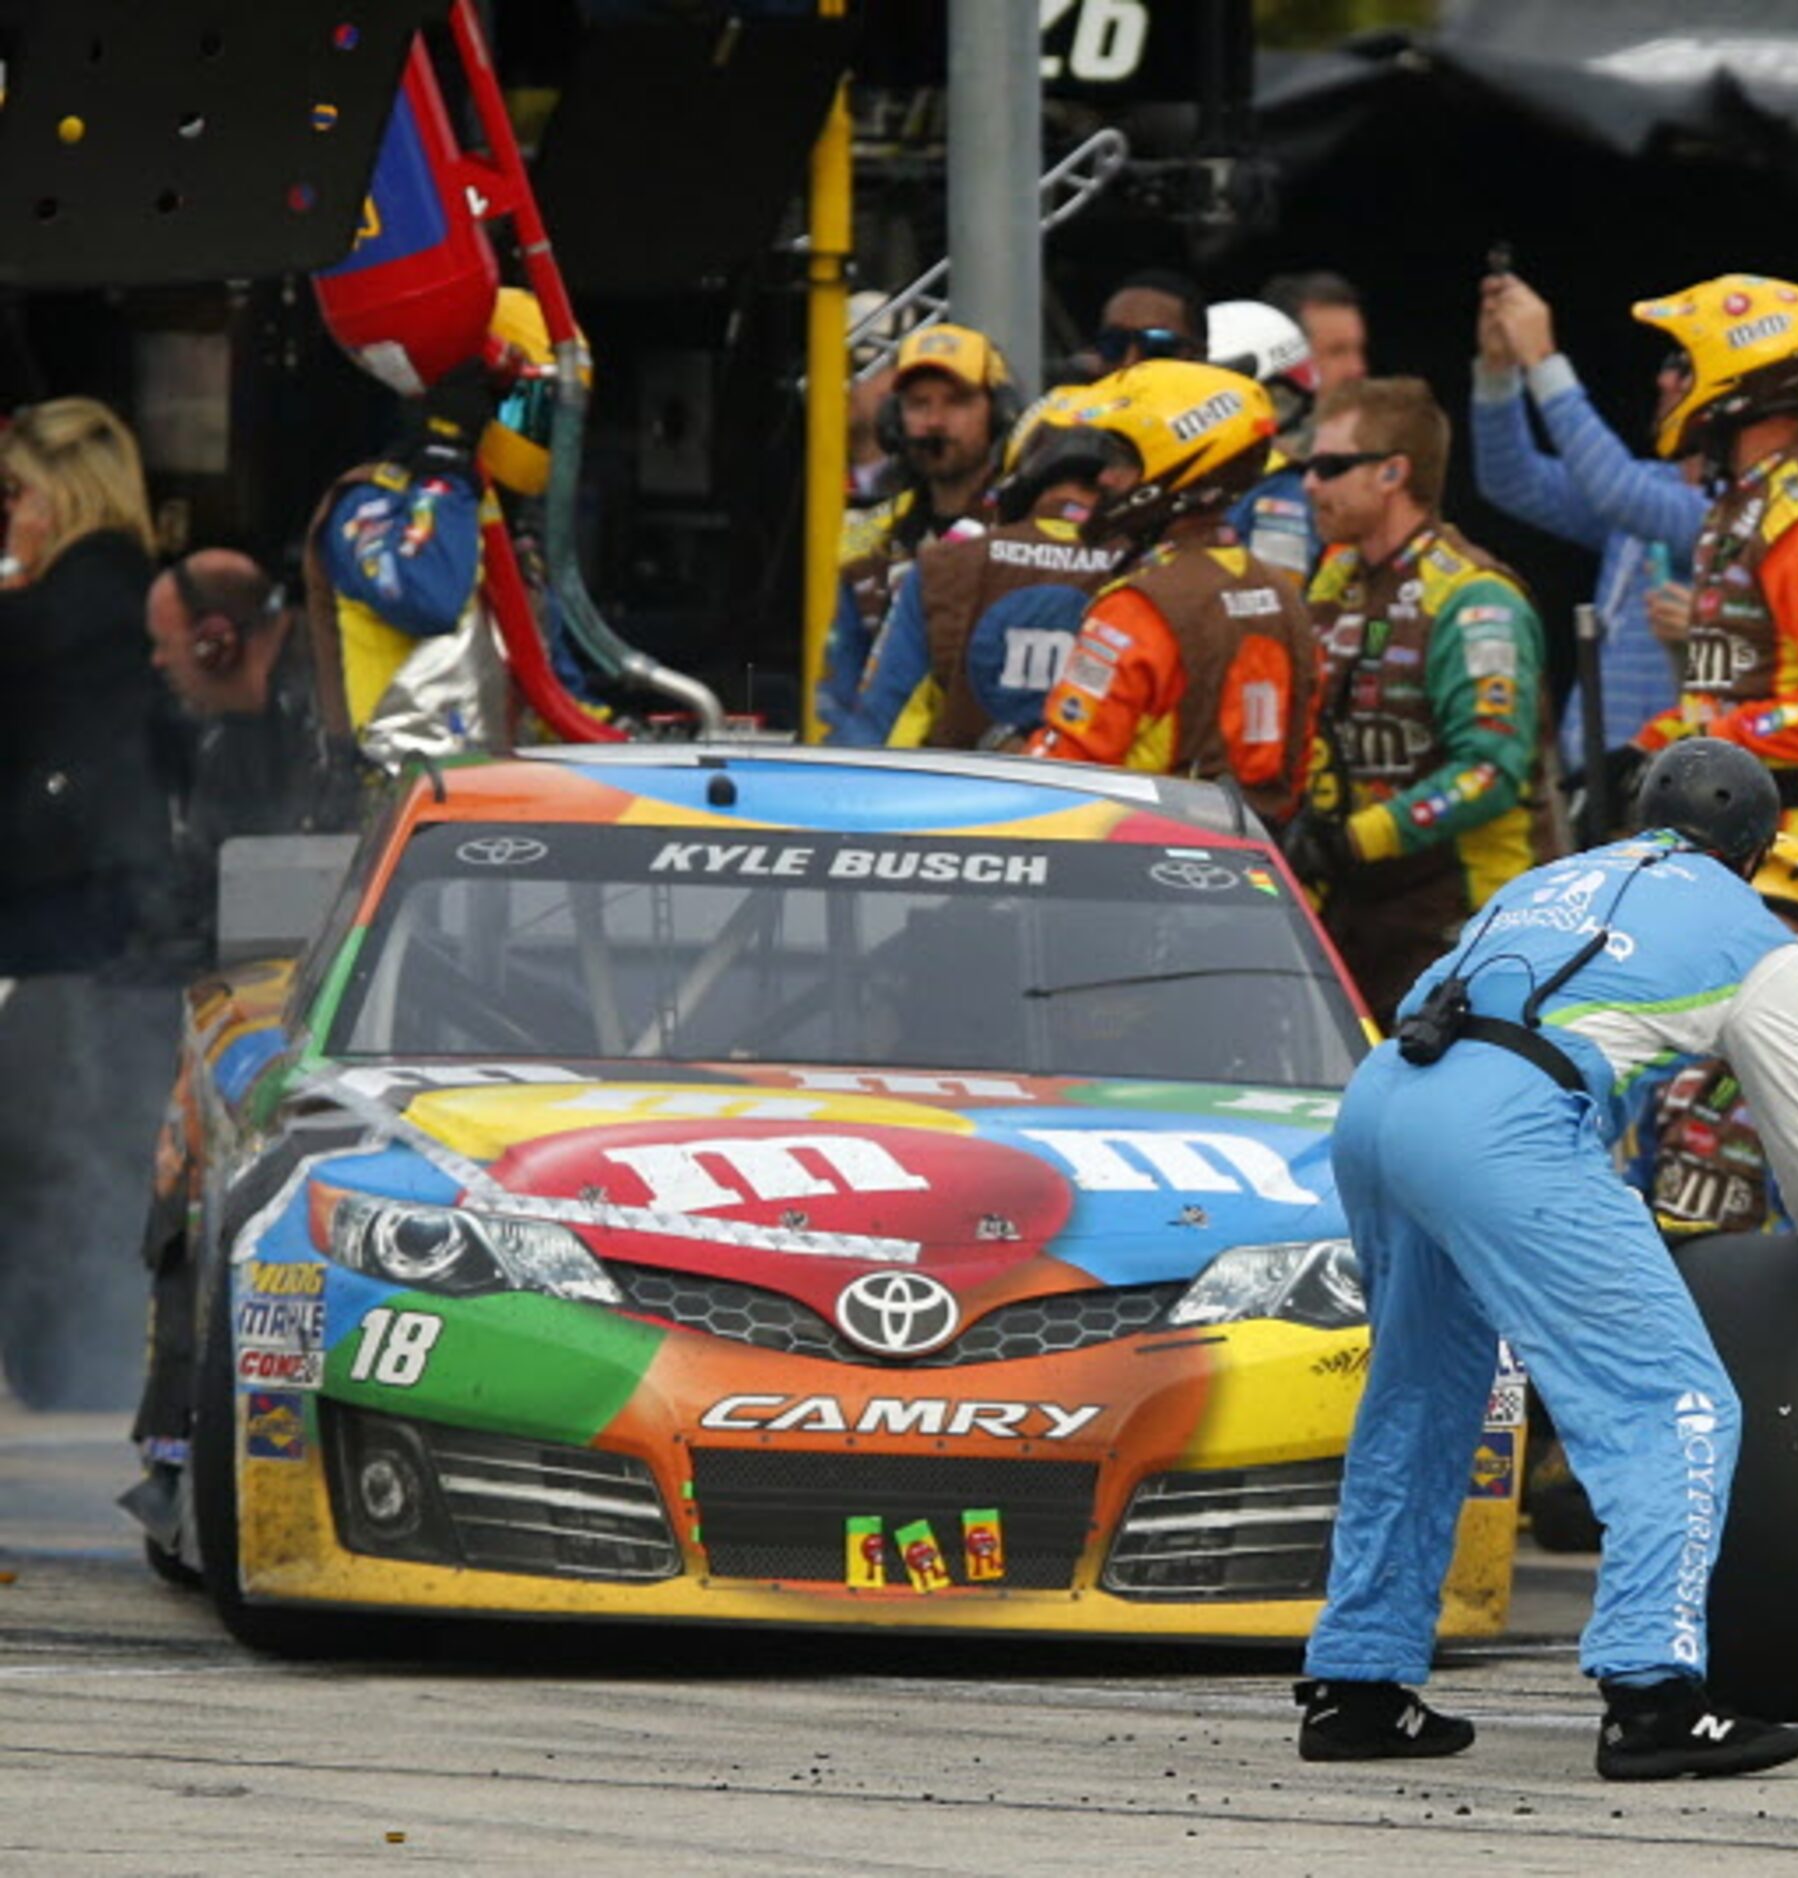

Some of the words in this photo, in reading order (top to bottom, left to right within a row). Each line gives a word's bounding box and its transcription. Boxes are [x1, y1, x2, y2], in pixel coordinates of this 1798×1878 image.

[649, 843, 814, 876] KYLE
[828, 848, 1049, 886] BUSCH
[602, 1134, 931, 1212] m
[1018, 1128, 1322, 1205] m
[349, 1308, 443, 1386] 18
[701, 1394, 1105, 1439] CAMRY
[1396, 1704, 1428, 1739] N
[1691, 1712, 1736, 1742] N
